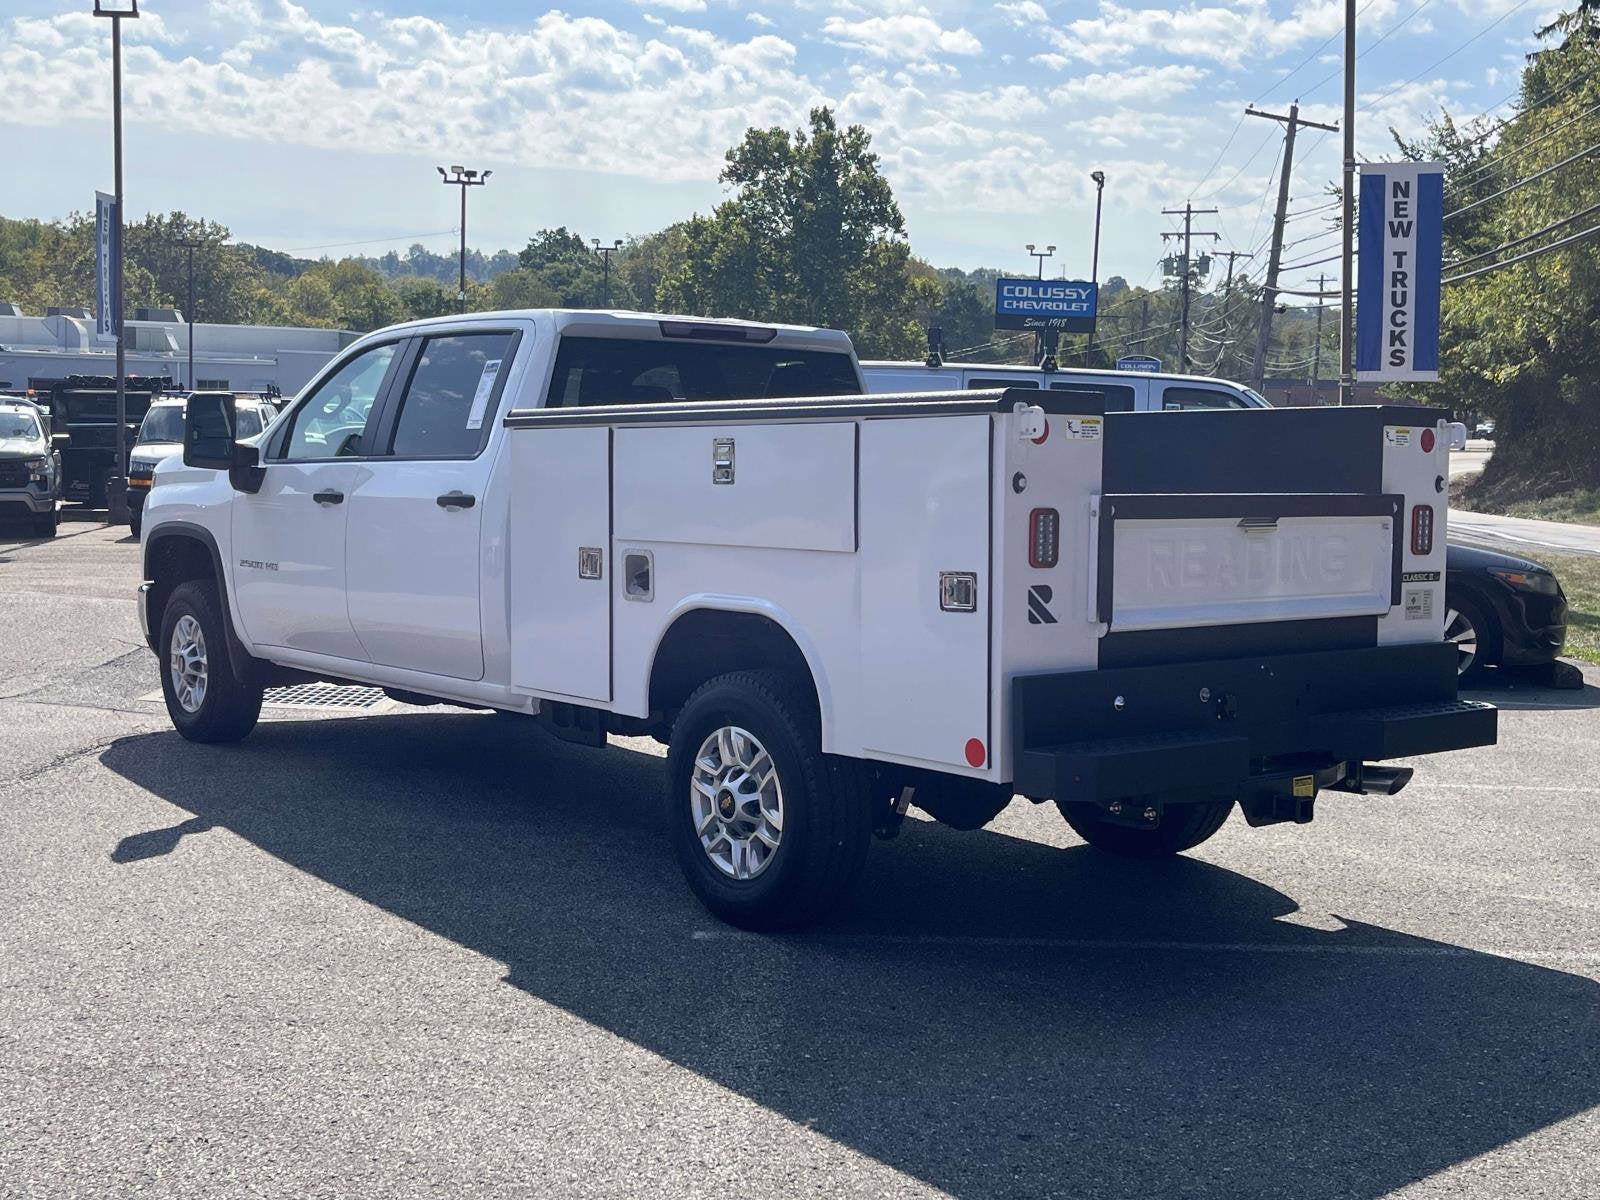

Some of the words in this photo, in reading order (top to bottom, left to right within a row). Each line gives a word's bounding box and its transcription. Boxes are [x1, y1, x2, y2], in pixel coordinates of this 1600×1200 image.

[1388, 181, 1413, 238] NEW
[102, 253, 110, 332] TRUCKS
[1003, 285, 1092, 300] COLUSSY
[1003, 300, 1090, 311] CHEVROLET
[1388, 251, 1408, 367] TRUCKS
[1024, 318, 1046, 327] Since
[1048, 318, 1067, 328] 1918
[239, 559, 263, 569] 2500
[1146, 536, 1349, 592] READING
[1403, 573, 1428, 581] CLASSIC
